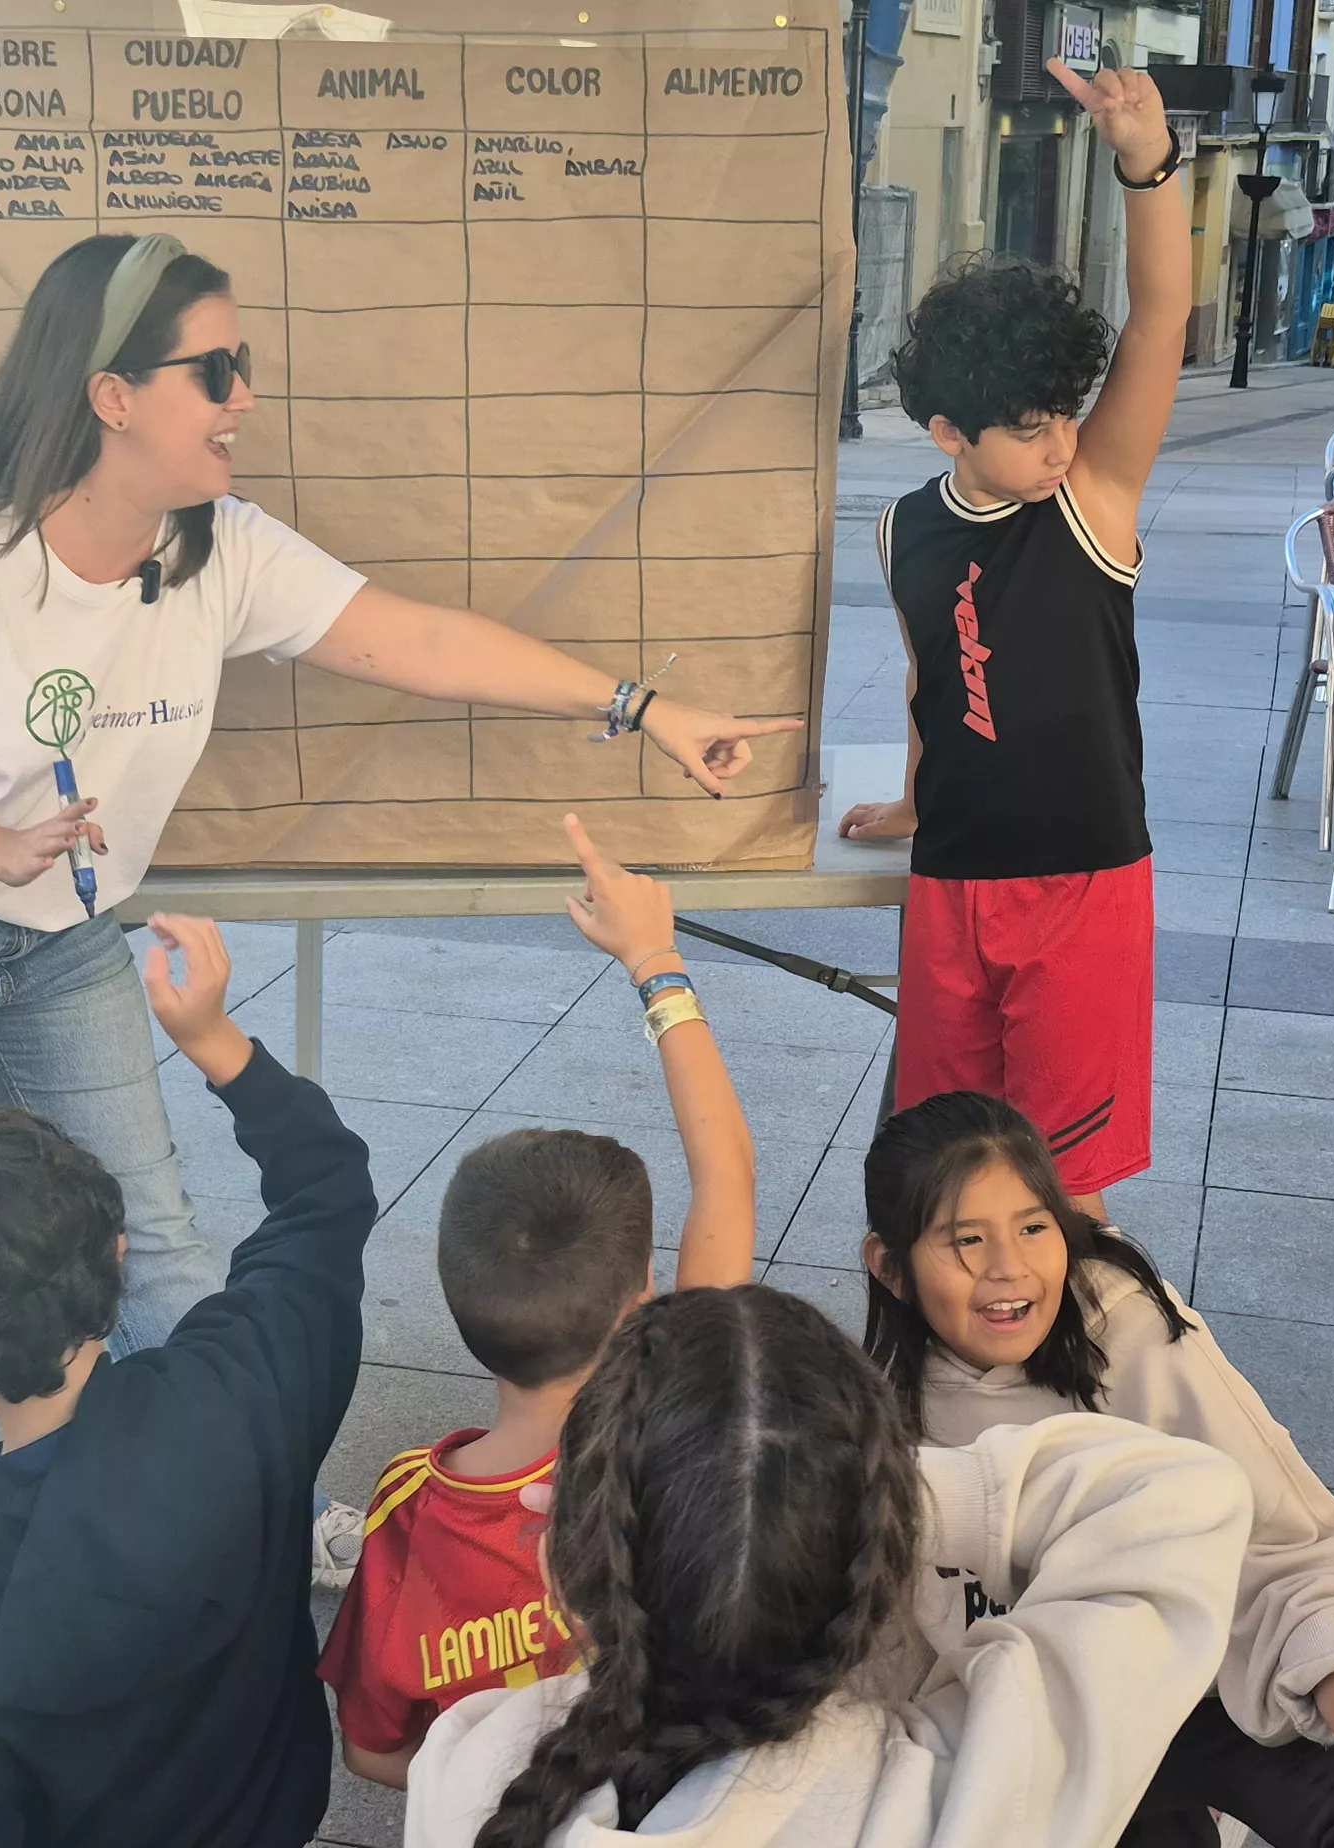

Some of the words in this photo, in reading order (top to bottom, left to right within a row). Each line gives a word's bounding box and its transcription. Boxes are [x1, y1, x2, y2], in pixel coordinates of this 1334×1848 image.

[124, 38, 247, 69] CIUDAD/
[318, 68, 425, 100] ANIMAL
[505, 66, 601, 97] COLOR
[664, 66, 803, 97] ALIMENTO
[132, 88, 243, 122] PUEBLO
[292, 131, 362, 150] ABEJA
[386, 131, 448, 150] ASNO
[22, 155, 85, 175] ALMA
[189, 149, 282, 167] ALBACETE
[472, 159, 524, 175] AZUL
[7, 199, 65, 218] ALBA
[90, 705, 147, 729] eimer
